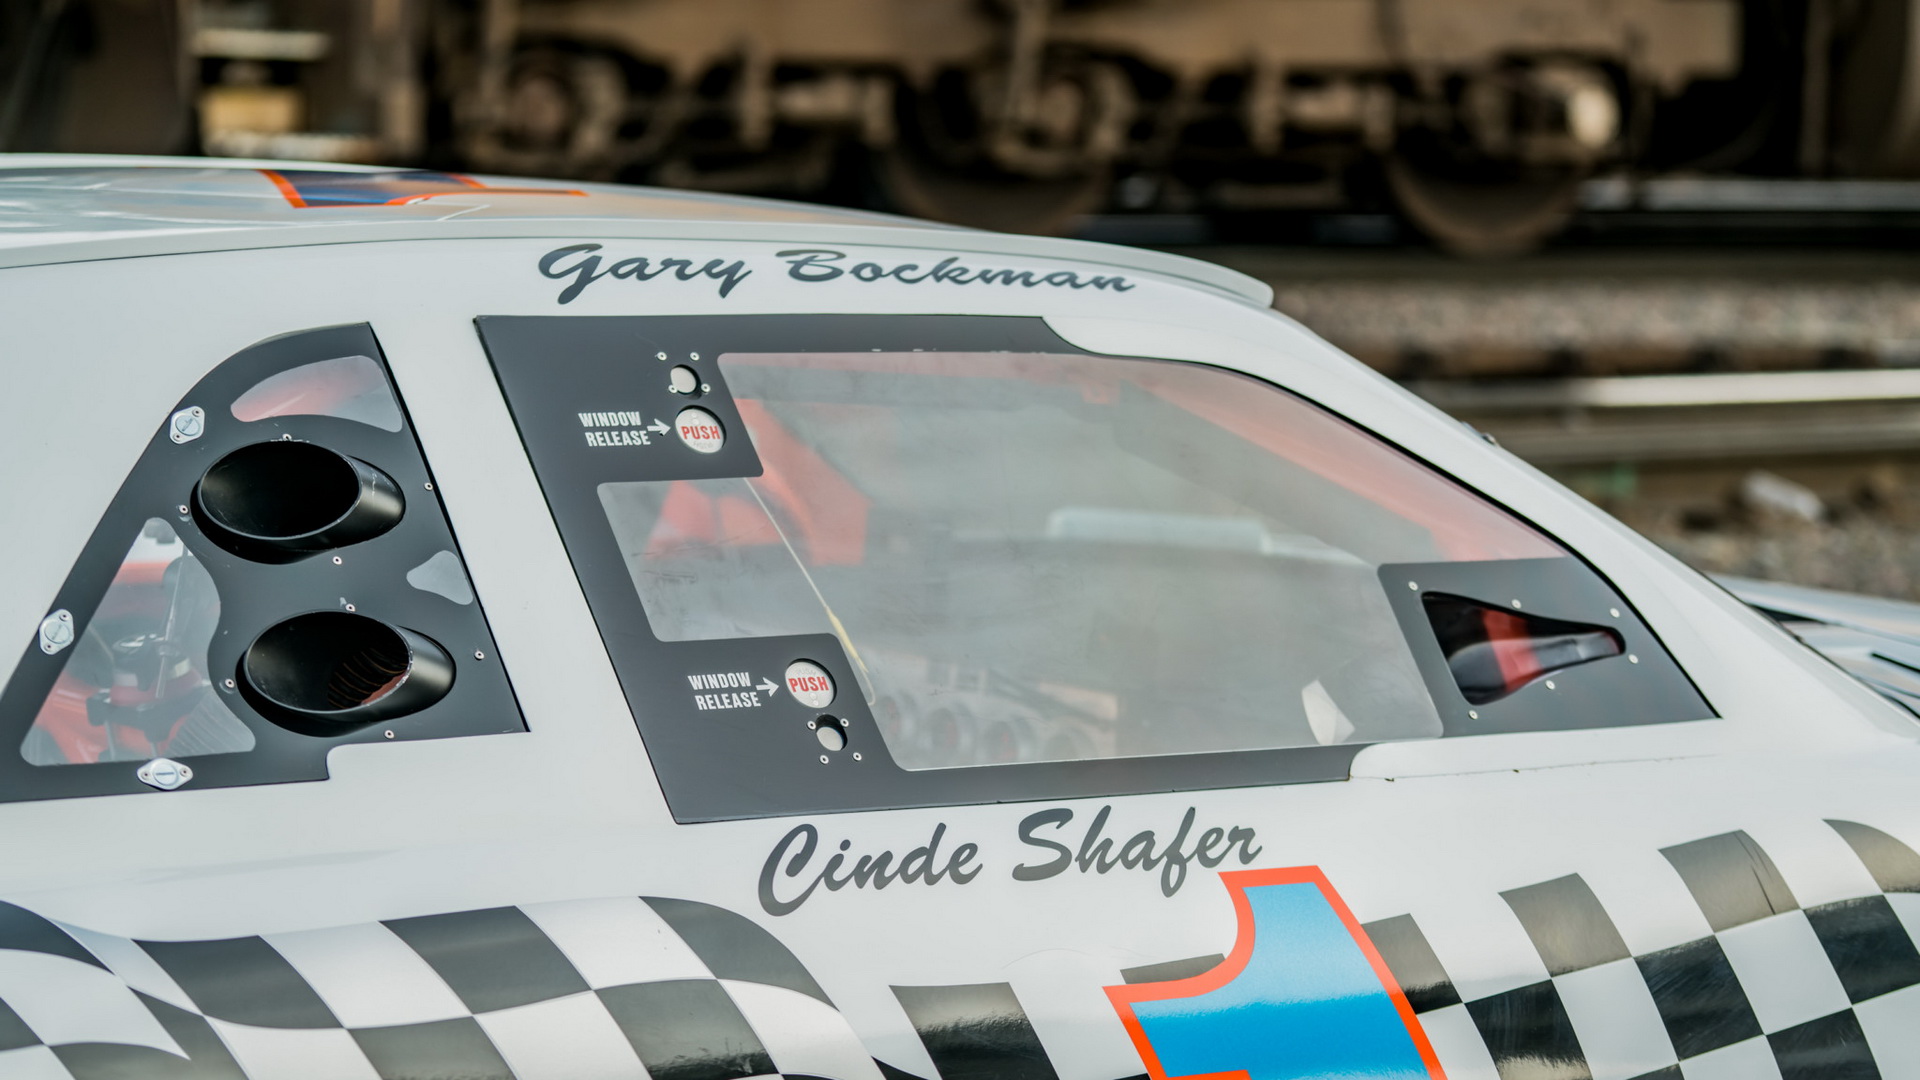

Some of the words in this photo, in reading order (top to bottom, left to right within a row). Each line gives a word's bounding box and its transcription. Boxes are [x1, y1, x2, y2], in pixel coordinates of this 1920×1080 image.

[538, 243, 752, 305] Gary
[775, 249, 1135, 292] Bockman
[578, 411, 642, 428] WINDOW
[585, 430, 651, 447] RELEASE
[680, 425, 721, 440] PUSH
[688, 672, 751, 691] WINDOW
[788, 676, 829, 693] PUSH
[695, 692, 762, 711] RELEASE
[757, 822, 983, 917] Cinde
[1012, 805, 1263, 898] Shafer
